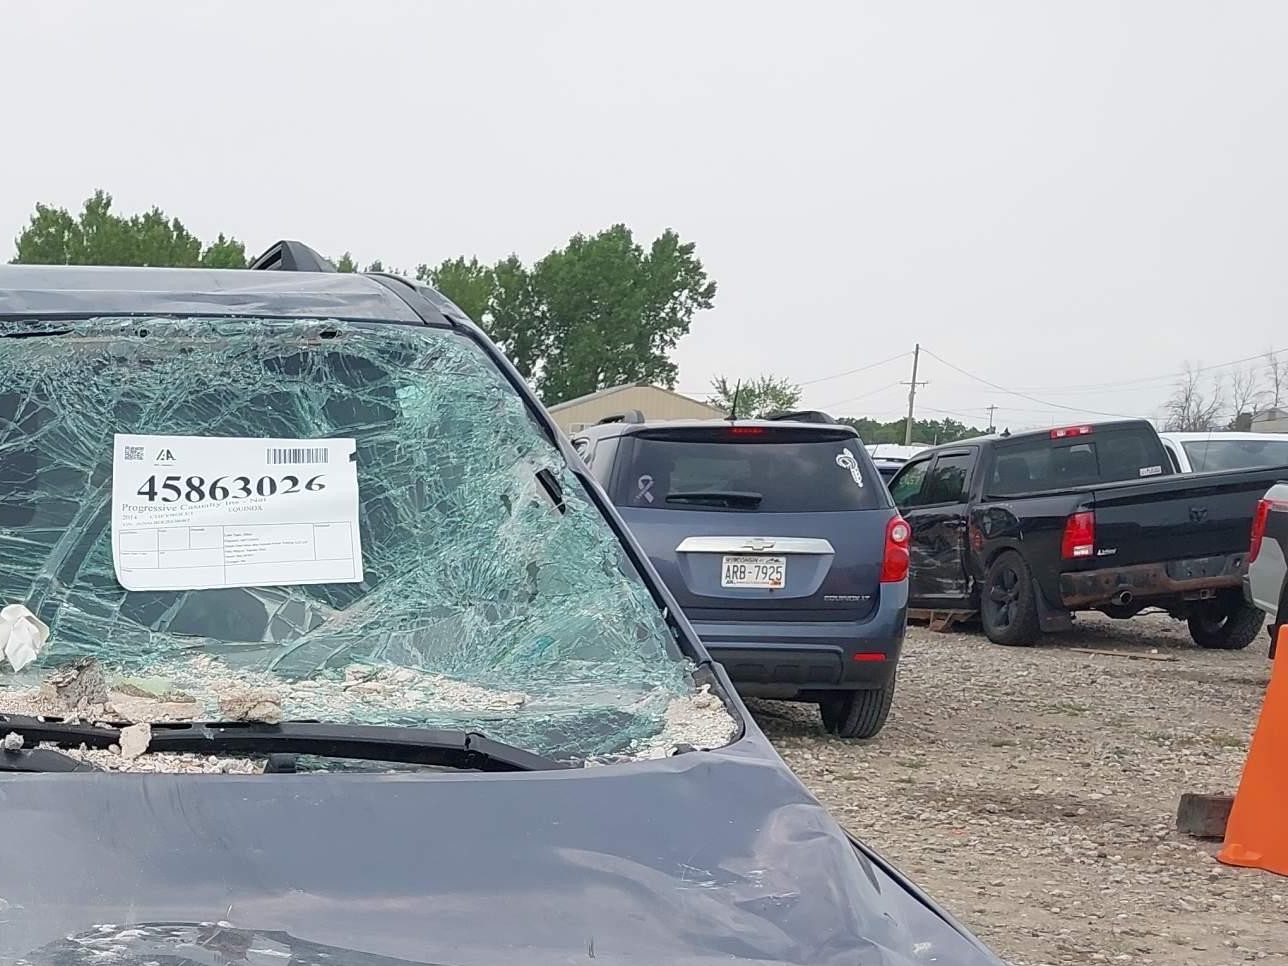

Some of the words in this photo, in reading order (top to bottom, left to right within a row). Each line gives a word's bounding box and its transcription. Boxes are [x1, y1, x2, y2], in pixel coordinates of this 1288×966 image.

[137, 474, 327, 502] 45863026
[122, 503, 177, 513] Progressive
[228, 505, 264, 513] EQUINOX
[725, 564, 783, 581] ARB-7925
